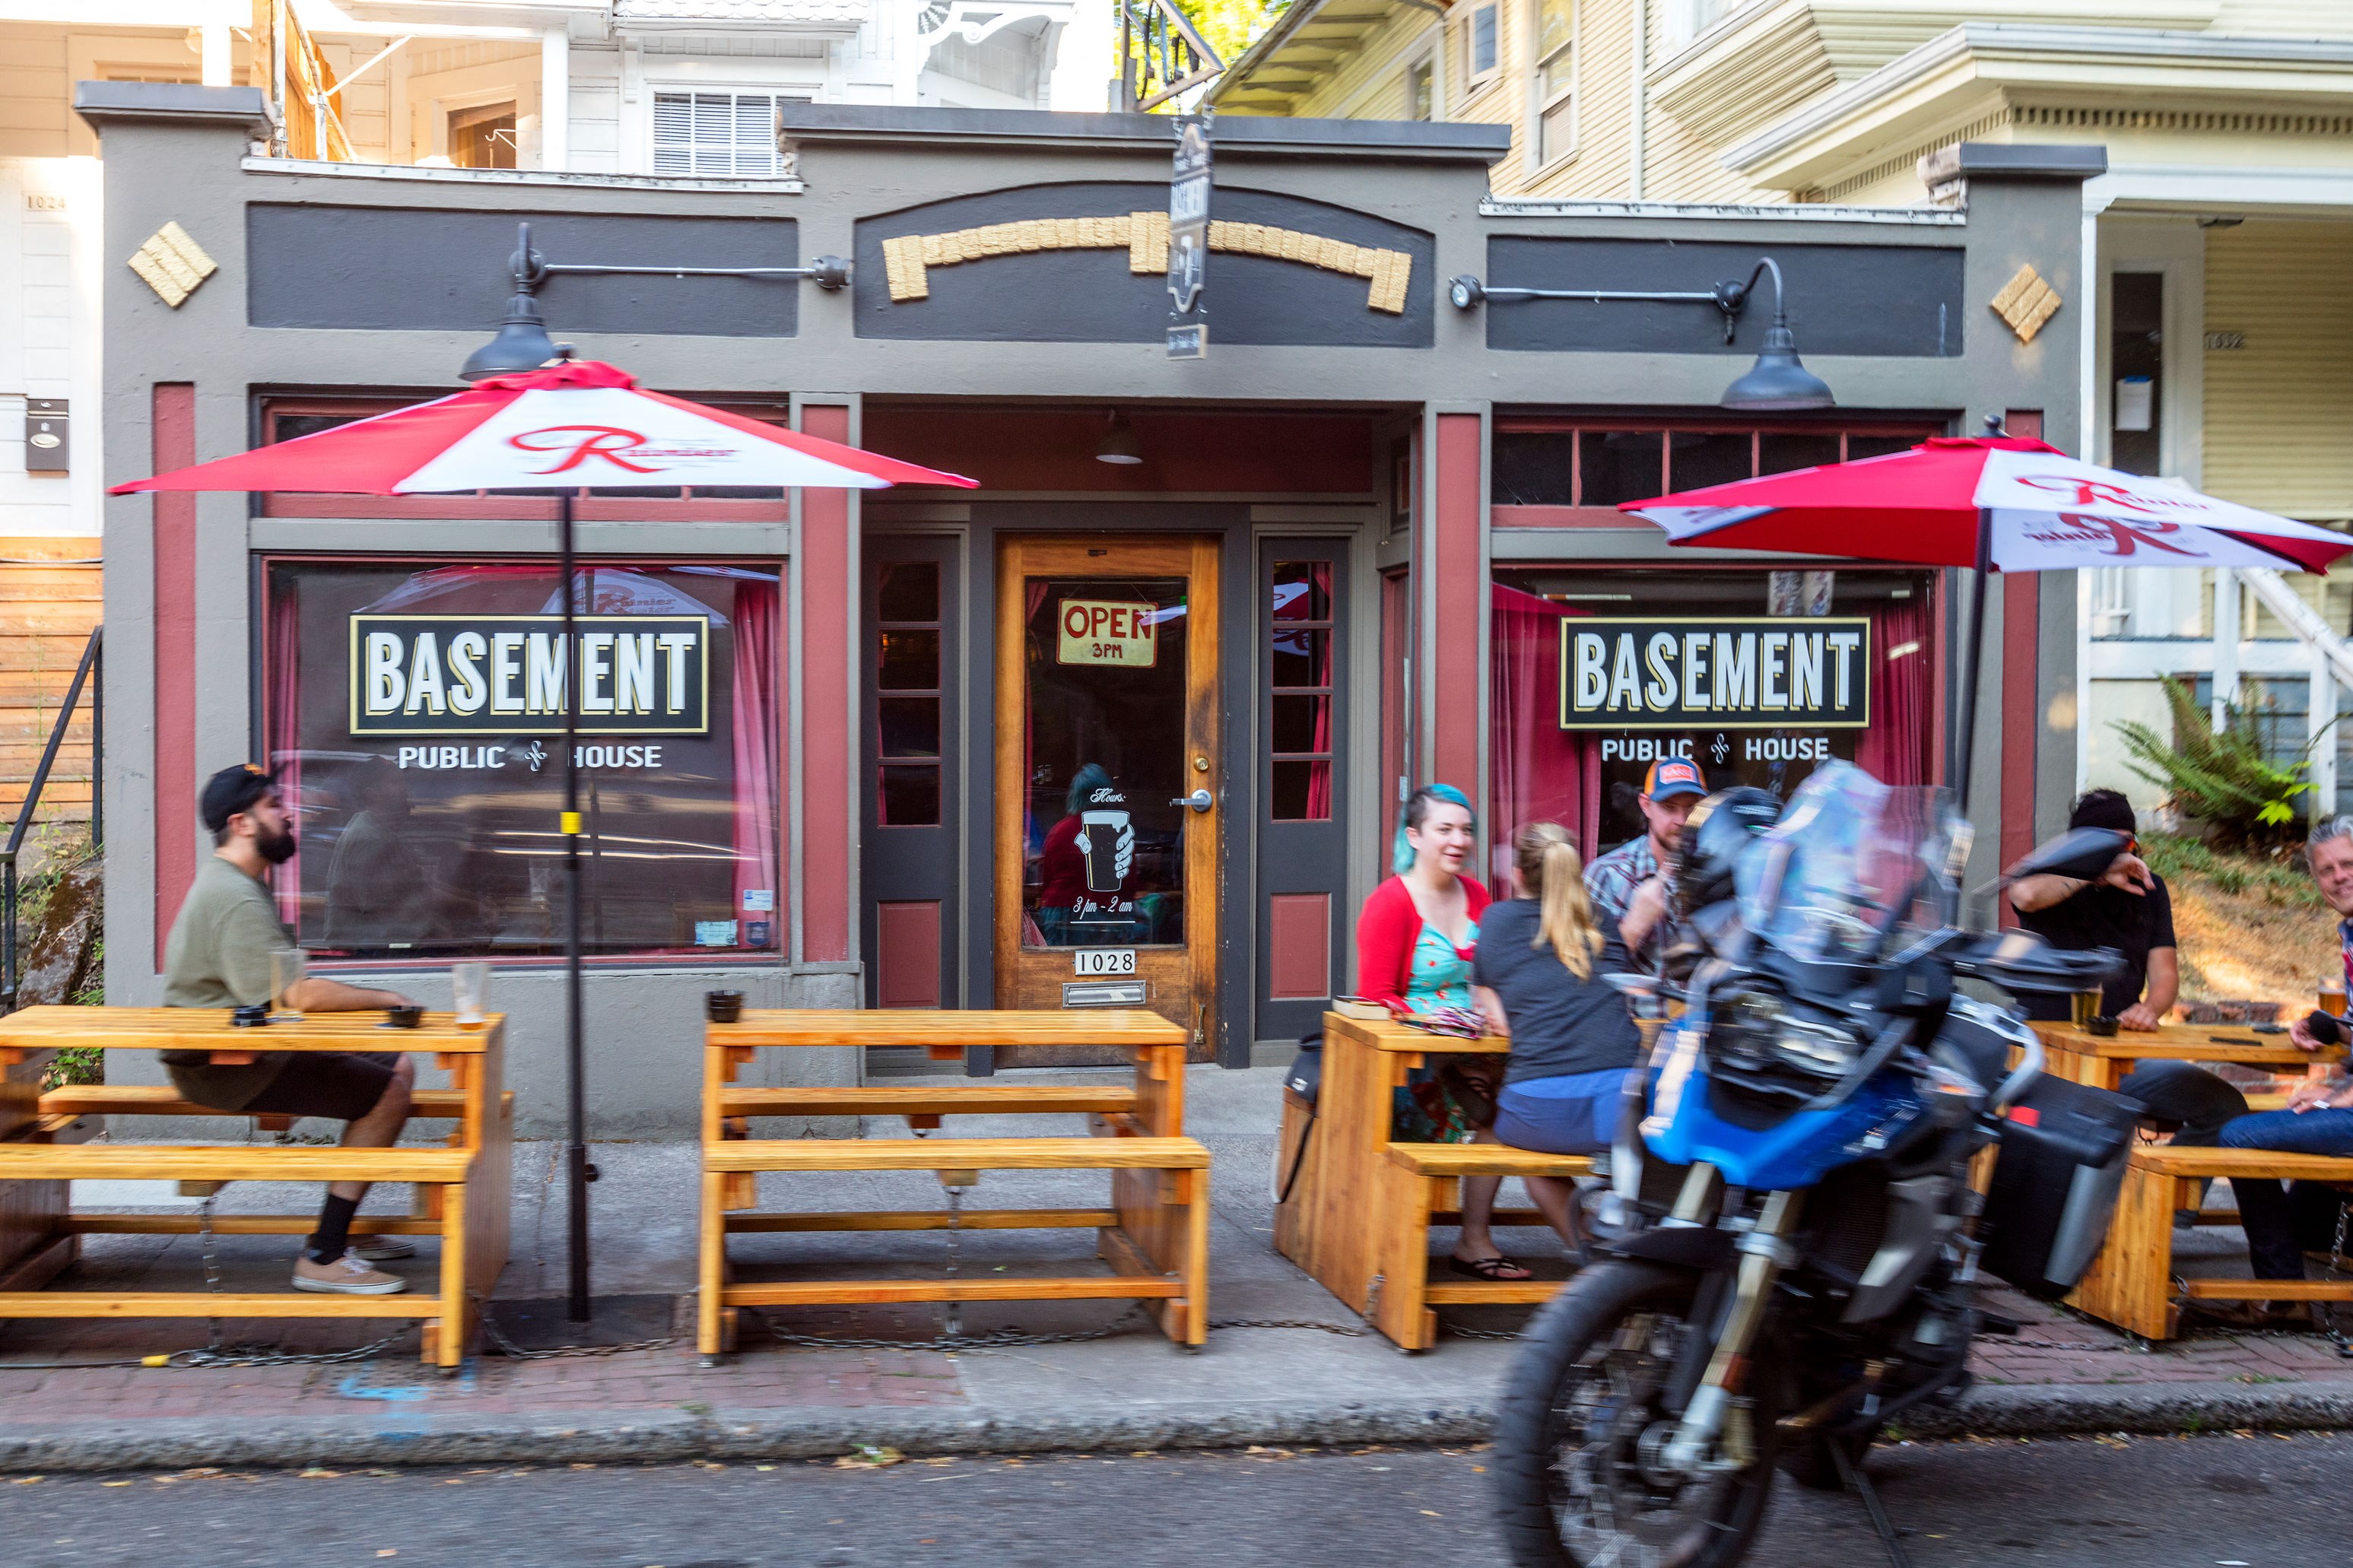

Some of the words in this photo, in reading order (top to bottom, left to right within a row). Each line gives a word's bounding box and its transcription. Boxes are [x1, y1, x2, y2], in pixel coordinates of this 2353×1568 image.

[1065, 605, 1151, 639] OPEN
[1092, 643, 1123, 659] 3PM
[365, 631, 697, 716] BASEMENT
[1574, 632, 1859, 713] BASEMENT
[399, 746, 506, 769] PUBLIC
[1602, 738, 1694, 761] PUBLIC
[1745, 737, 1829, 760] HOUSE
[1107, 896, 1119, 912] 2
[1119, 901, 1133, 912] am
[1081, 954, 1132, 971] 1028
